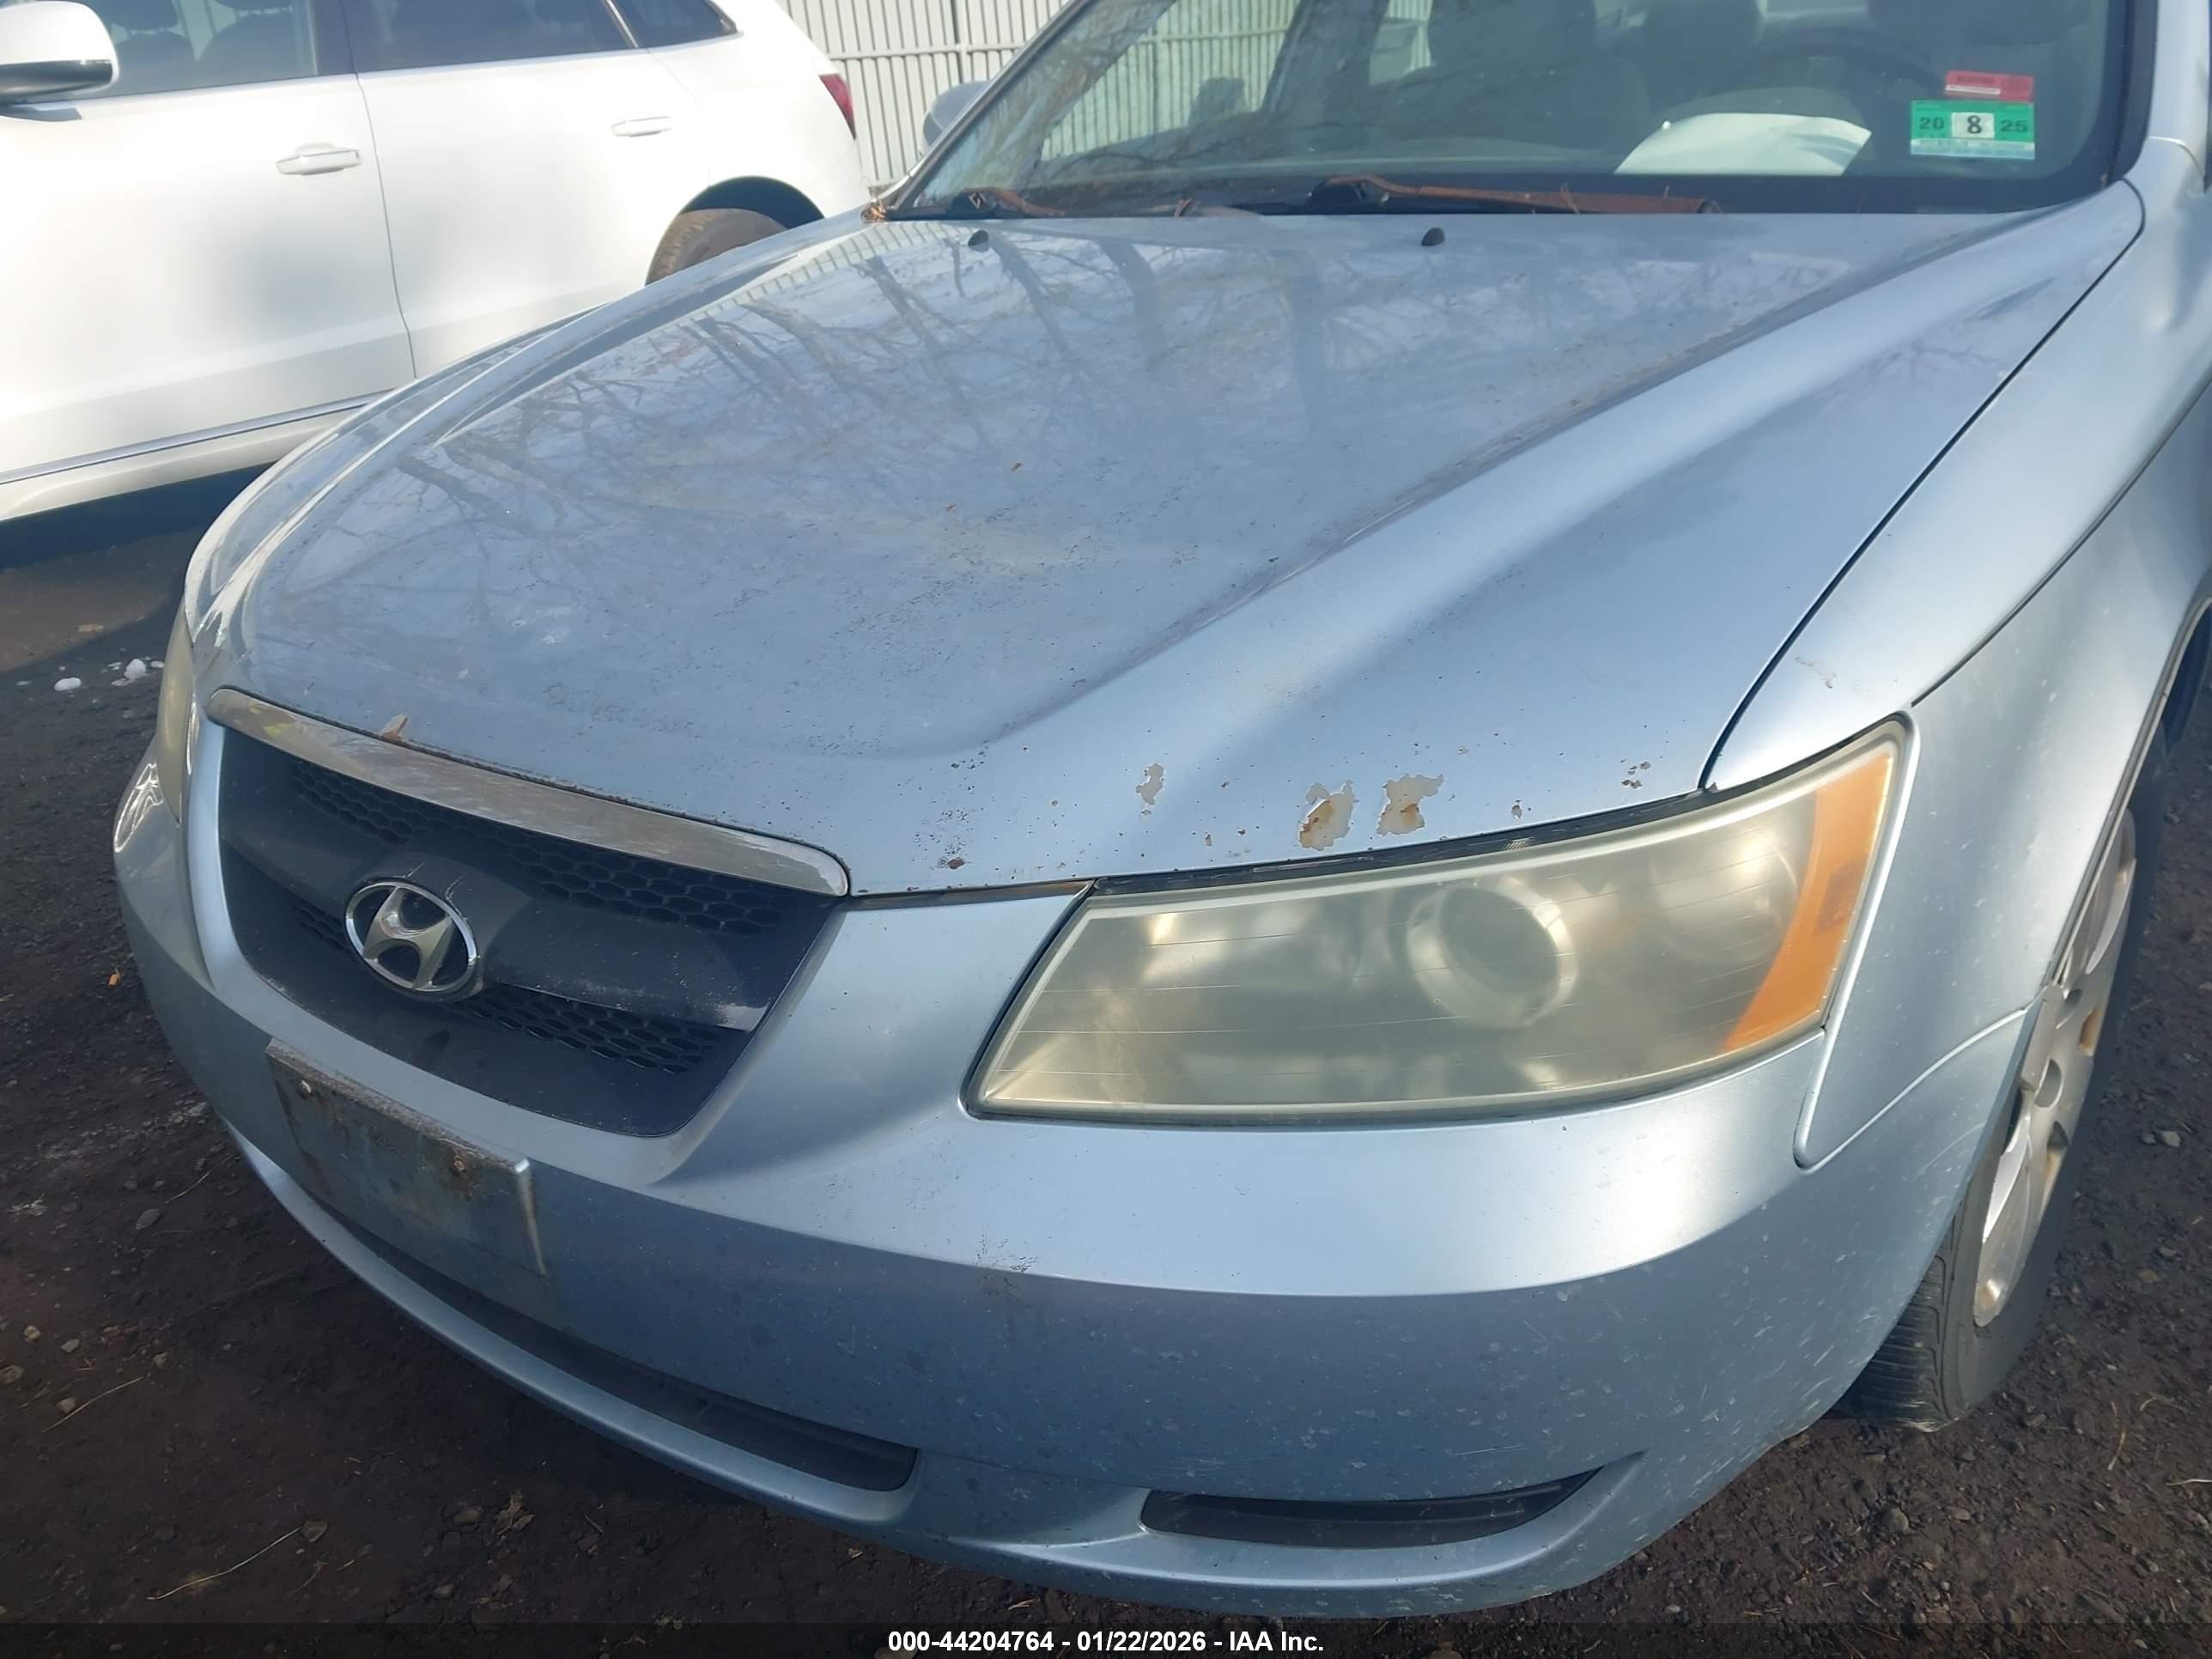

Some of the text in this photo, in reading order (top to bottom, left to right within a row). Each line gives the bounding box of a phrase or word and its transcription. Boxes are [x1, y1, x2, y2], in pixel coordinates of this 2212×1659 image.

[1919, 114, 2028, 134] 20 8 25
